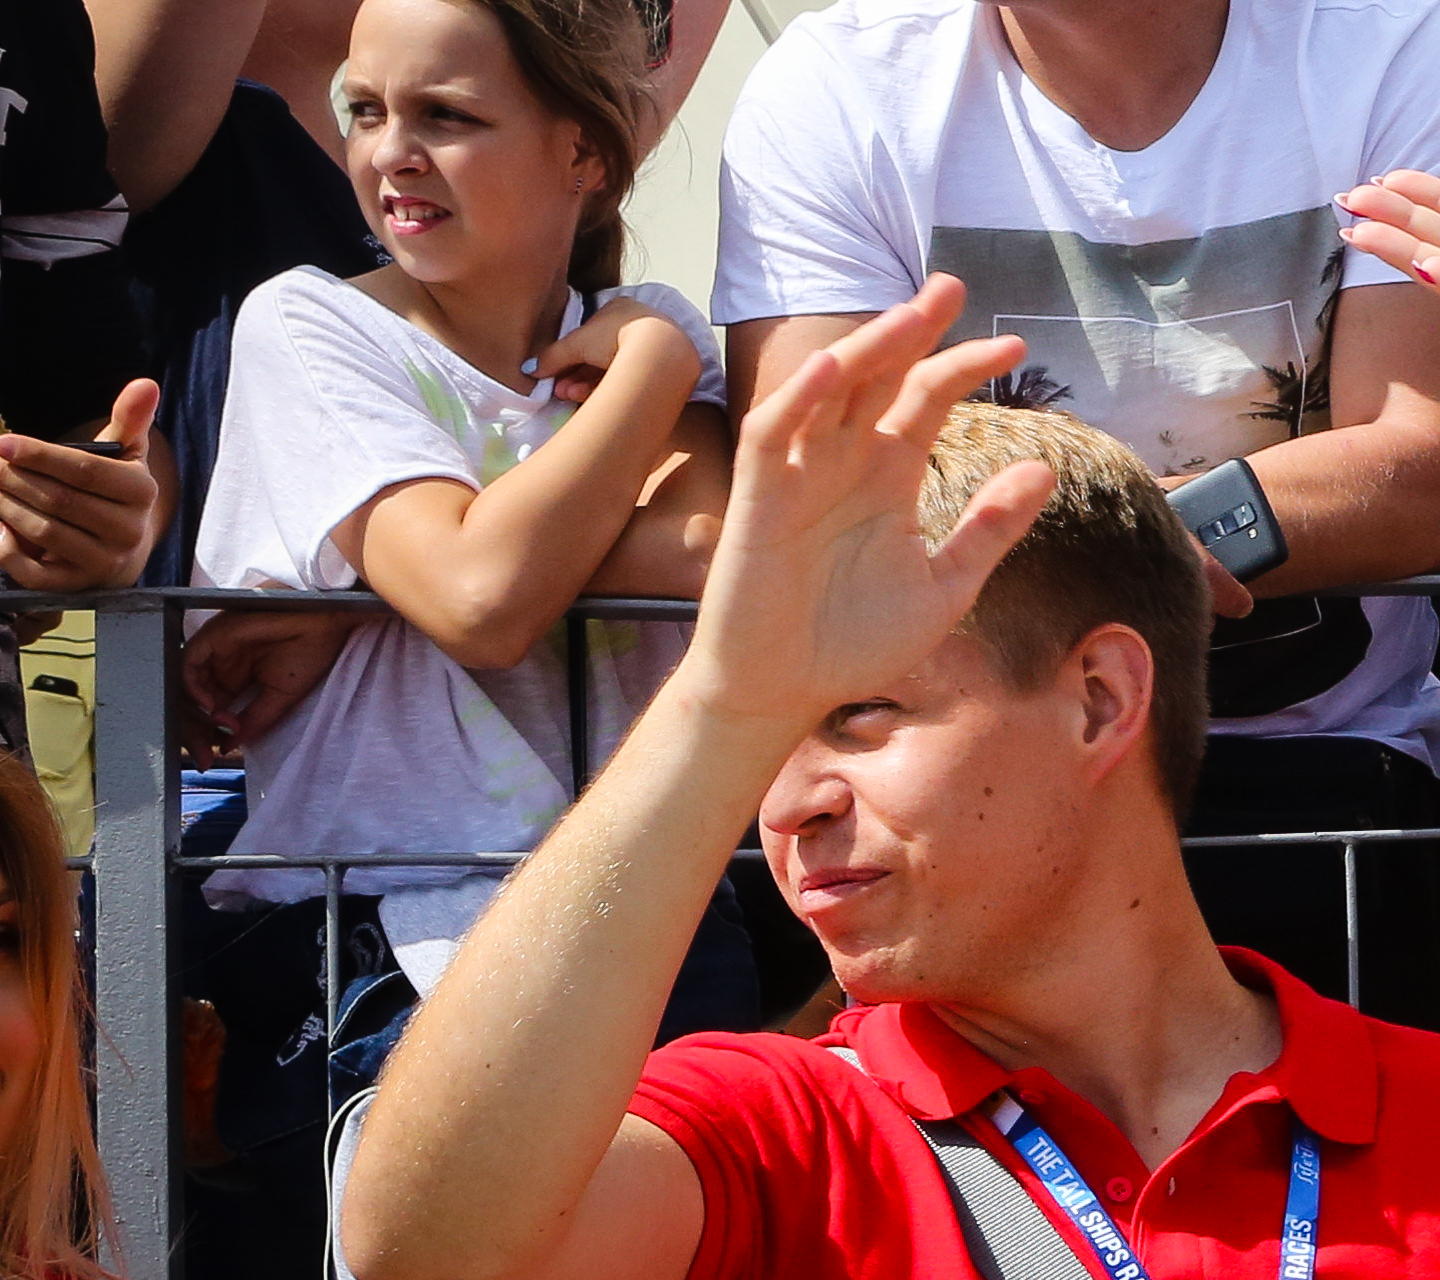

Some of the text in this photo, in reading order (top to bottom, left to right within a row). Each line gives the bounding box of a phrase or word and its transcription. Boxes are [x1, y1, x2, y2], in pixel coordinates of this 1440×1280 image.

[1027, 1136, 1059, 1176] THE
[1050, 1170, 1097, 1216] TALL
[1080, 1208, 1130, 1268] SHIPS
[1285, 1218, 1314, 1280] RACES
